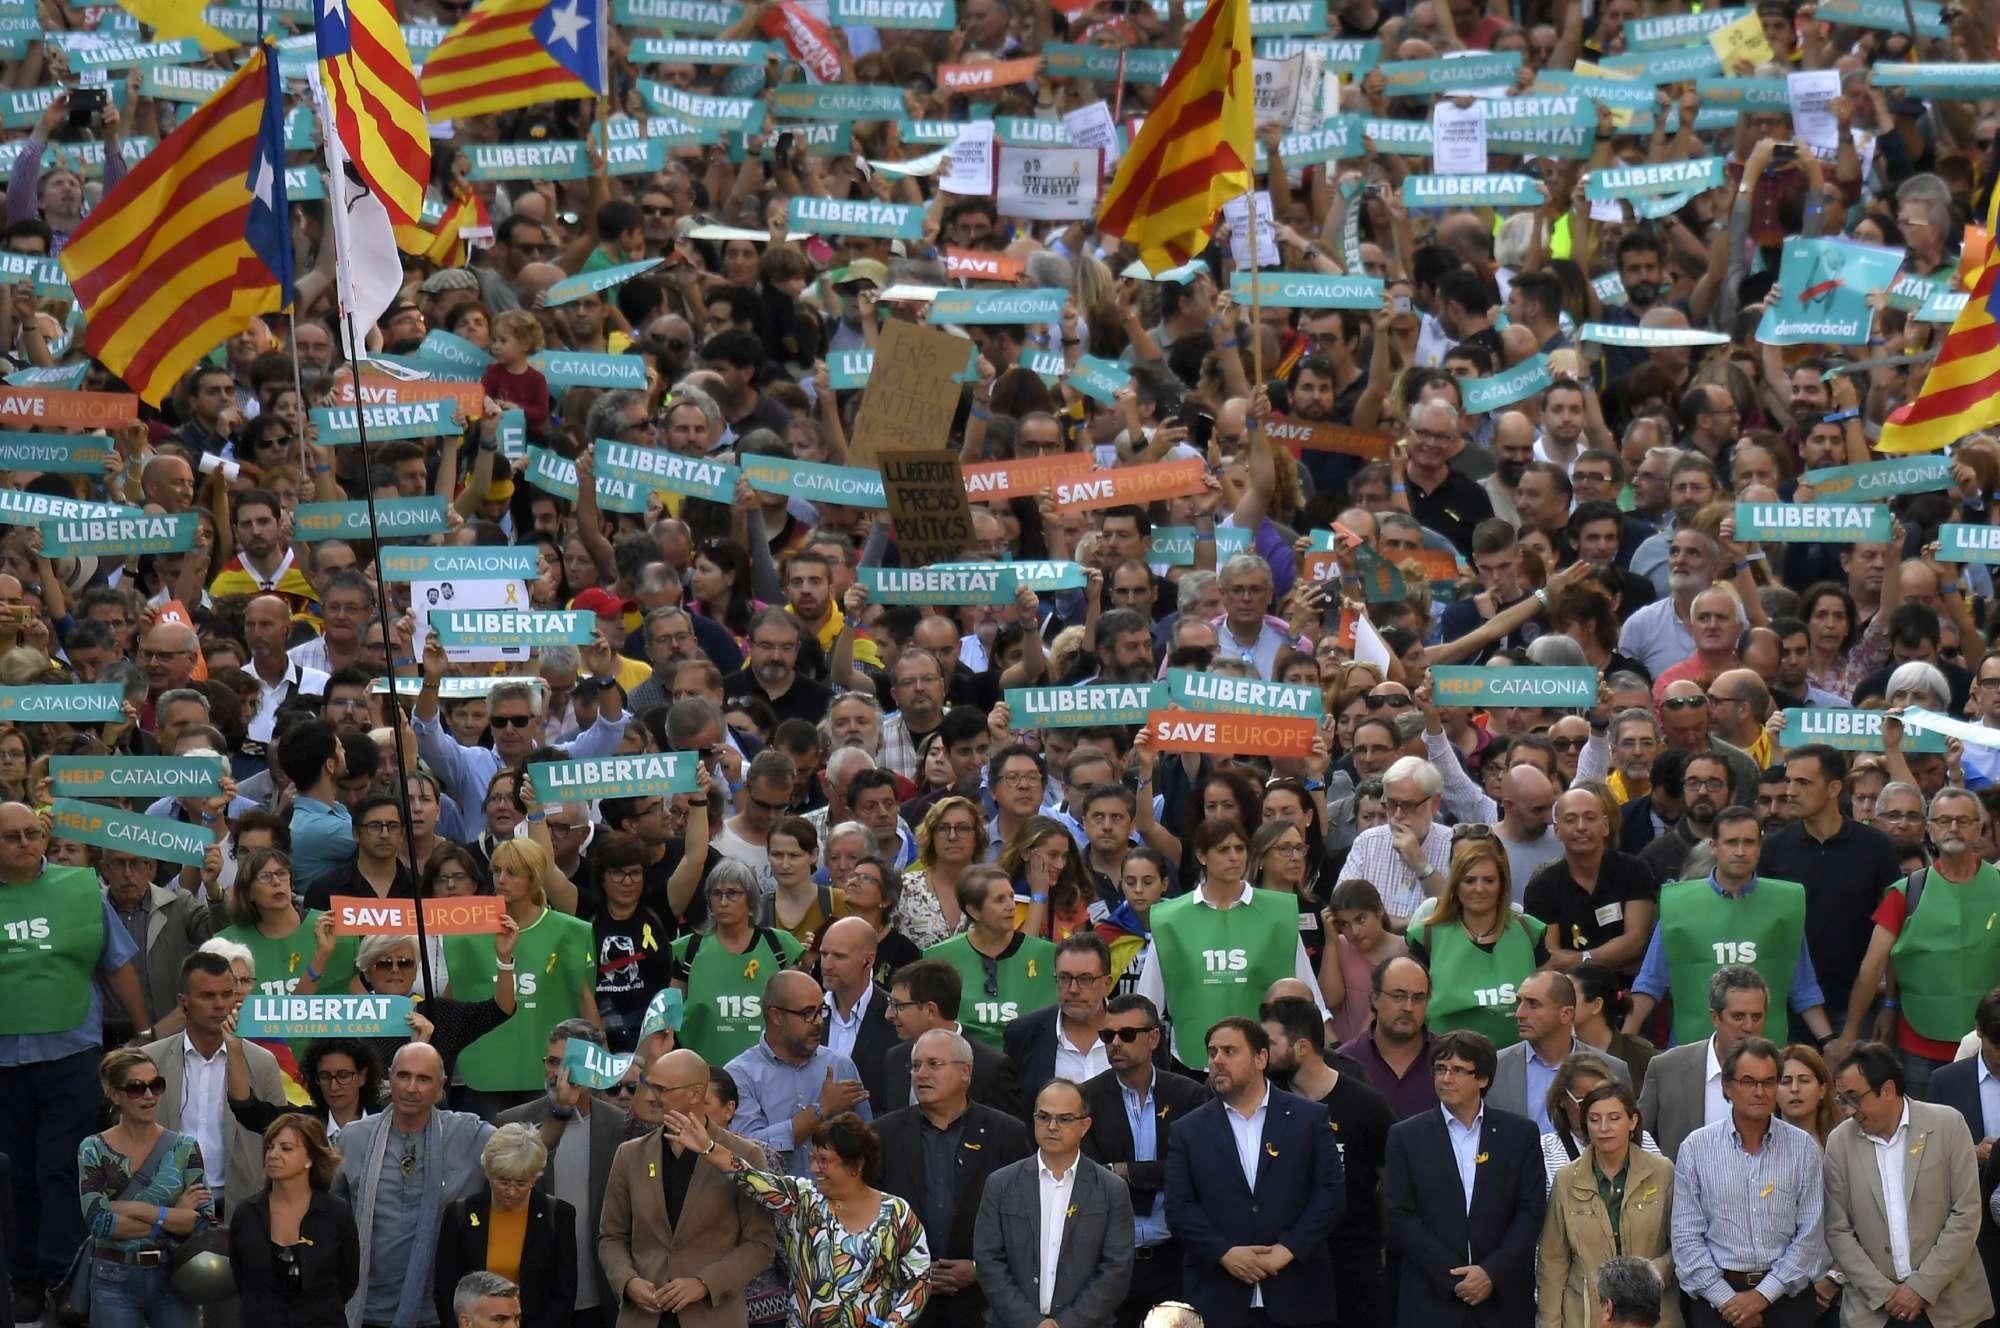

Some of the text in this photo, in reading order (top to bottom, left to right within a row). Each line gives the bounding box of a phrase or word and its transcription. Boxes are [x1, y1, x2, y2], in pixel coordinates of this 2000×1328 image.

[839, 0, 945, 19] LLIBERTAT
[81, 39, 182, 63] LLIBERTAT
[645, 41, 751, 56] LLIBERTAT
[945, 70, 994, 85] SAVE
[653, 85, 754, 119] LLIBERTAT
[819, 90, 903, 111] CATALONIA
[476, 145, 577, 168] LLIBERTAT
[1602, 161, 1713, 188] LLIBERTAT
[1415, 177, 1525, 196] LLIBERTAT
[797, 199, 908, 225] LLIBERTAT
[947, 256, 998, 273] SAVE
[1284, 285, 1375, 299] CATALONIA
[976, 296, 1058, 313] CATALONIA
[550, 360, 640, 378] CATALONIA
[343, 385, 397, 405] SAVE
[1468, 367, 1547, 404] CATALONIA
[328, 404, 440, 430] LLIBERTAT
[1264, 422, 1312, 441] SAVE
[607, 446, 726, 487] LLIBERTAT
[793, 471, 885, 496] CATALONIA
[1858, 468, 1948, 488] CATALONIA
[1056, 479, 1114, 505] SAVE
[300, 509, 442, 529] HELP CATALONIA
[1753, 507, 1875, 528] LLIBERTAT
[57, 518, 178, 543] LLIBERTAT
[385, 557, 530, 571] HELP CATALONIA
[1313, 561, 1343, 581] SA
[876, 572, 1000, 591] LLIBERTAT
[451, 613, 577, 633] LLIBERTAT
[1184, 674, 1312, 710] LLIBERTAT
[1439, 678, 1589, 695] HELP CATALONIA
[20, 695, 120, 710] CATALONIA
[1025, 687, 1150, 712] LLIBERTAT
[1158, 722, 1308, 748] SAVE EUROPE
[59, 770, 212, 785] HELP CATALONIA
[549, 756, 677, 787] LLIBERTAT
[57, 811, 205, 854] HELP CATALONIA
[342, 904, 497, 928] SAVE EUROPE
[4, 917, 50, 941] 11S
[1202, 949, 1248, 972] 11S
[1712, 942, 1757, 964] 11S
[1473, 983, 1517, 1006] 11S
[254, 999, 391, 1021] LLIBERTAT
[716, 996, 762, 1018] 11S
[974, 1002, 1019, 1023] 11S
[263, 1024, 381, 1033] US VOLEM A CASA
